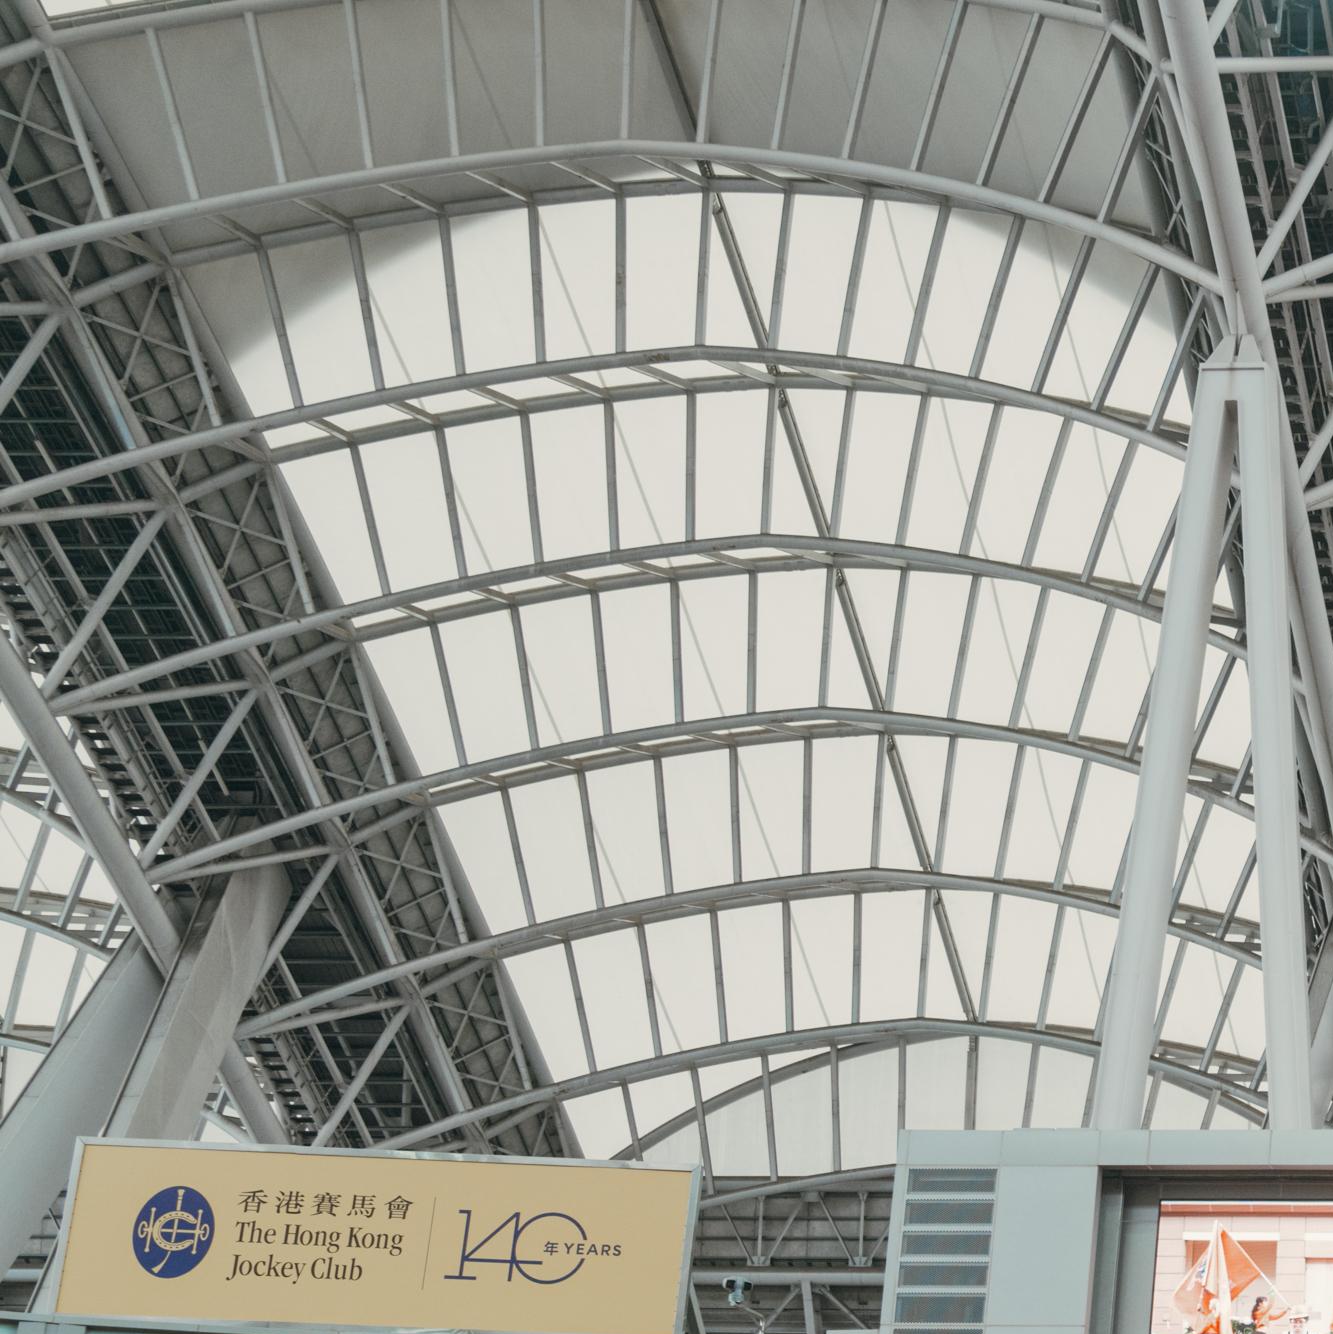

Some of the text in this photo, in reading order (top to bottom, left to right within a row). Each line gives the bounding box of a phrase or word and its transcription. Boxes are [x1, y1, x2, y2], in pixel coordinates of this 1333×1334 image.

[237, 1189, 414, 1221] 香港賽馬會
[235, 1221, 404, 1257] The Hong Kong
[564, 1242, 623, 1258] YEARS
[226, 1254, 364, 1285] Jockey Club
